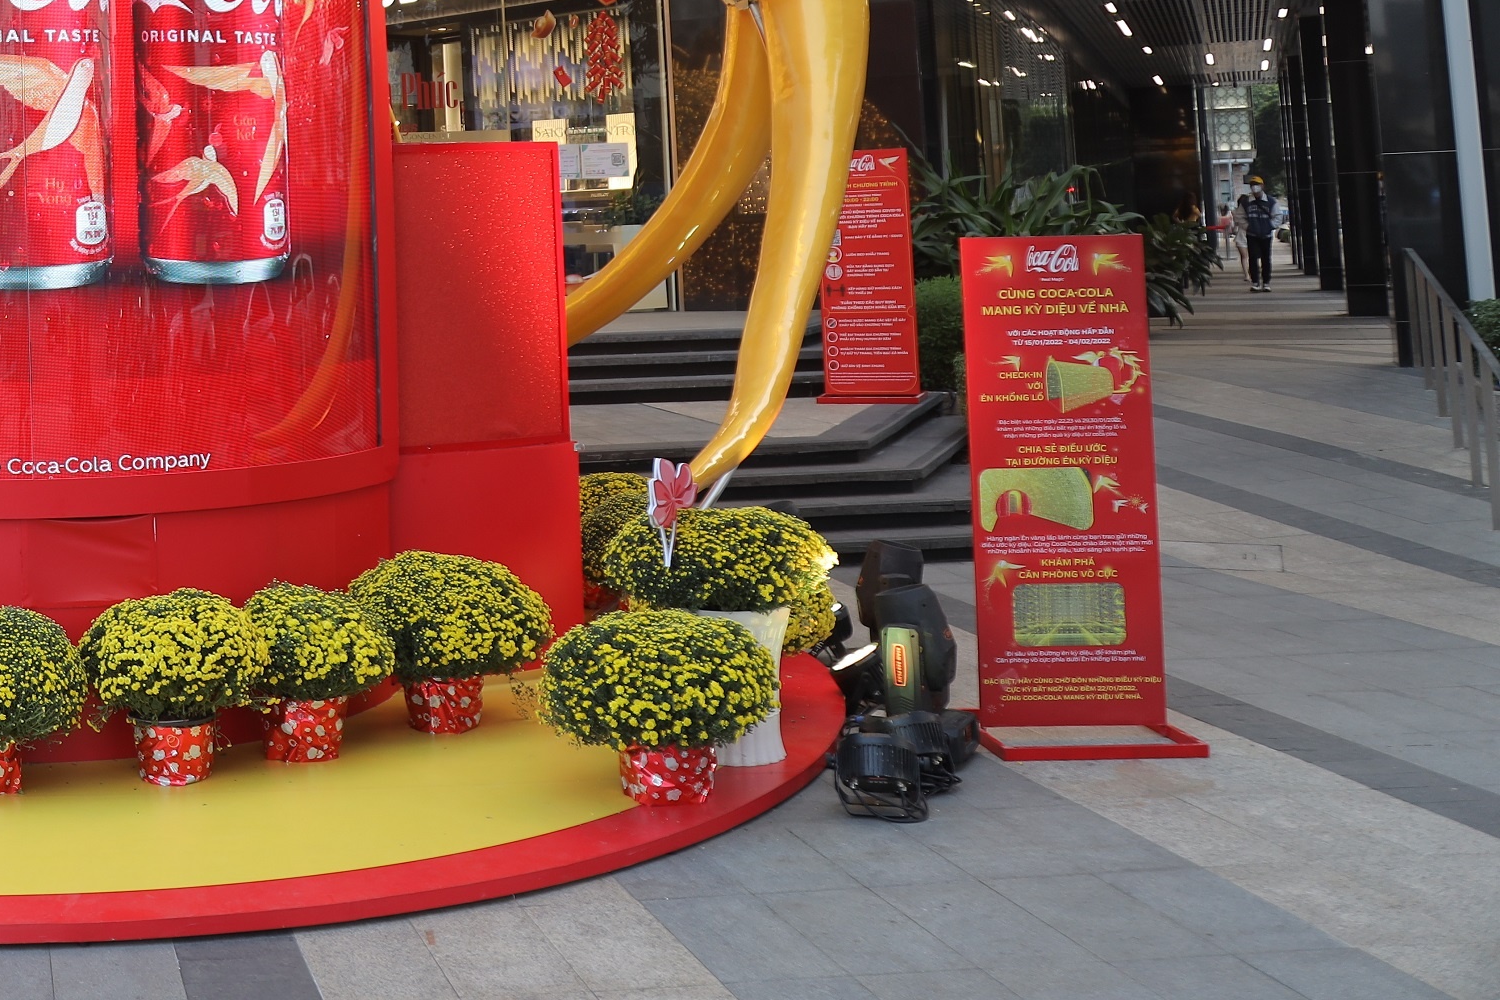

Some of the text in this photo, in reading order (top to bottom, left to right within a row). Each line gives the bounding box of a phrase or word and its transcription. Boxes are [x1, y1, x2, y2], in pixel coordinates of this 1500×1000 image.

[44, 29, 100, 42] TASTE
[141, 30, 276, 45] ORIGINAL TASTE
[401, 72, 458, 110] Phúc
[998, 287, 1114, 299] CÙNG COCA-COLA
[982, 300, 1129, 316] MANG KỲ DIỆU VỀ NHÀ
[999, 371, 1043, 379] CHECK-IN
[980, 394, 993, 402] ÉN
[1018, 446, 1042, 454] CHIA
[1044, 443, 1057, 453] SẺ
[7, 457, 112, 475] Coca-Cola
[118, 451, 211, 472] Company
[1006, 459, 1021, 467] TẠI
[1023, 456, 1060, 465] ĐƯỜNG
[1094, 455, 1118, 465] DIỆU
[1041, 558, 1095, 567] KHÁM PHÁ
[1042, 570, 1079, 578] PHÒNG
